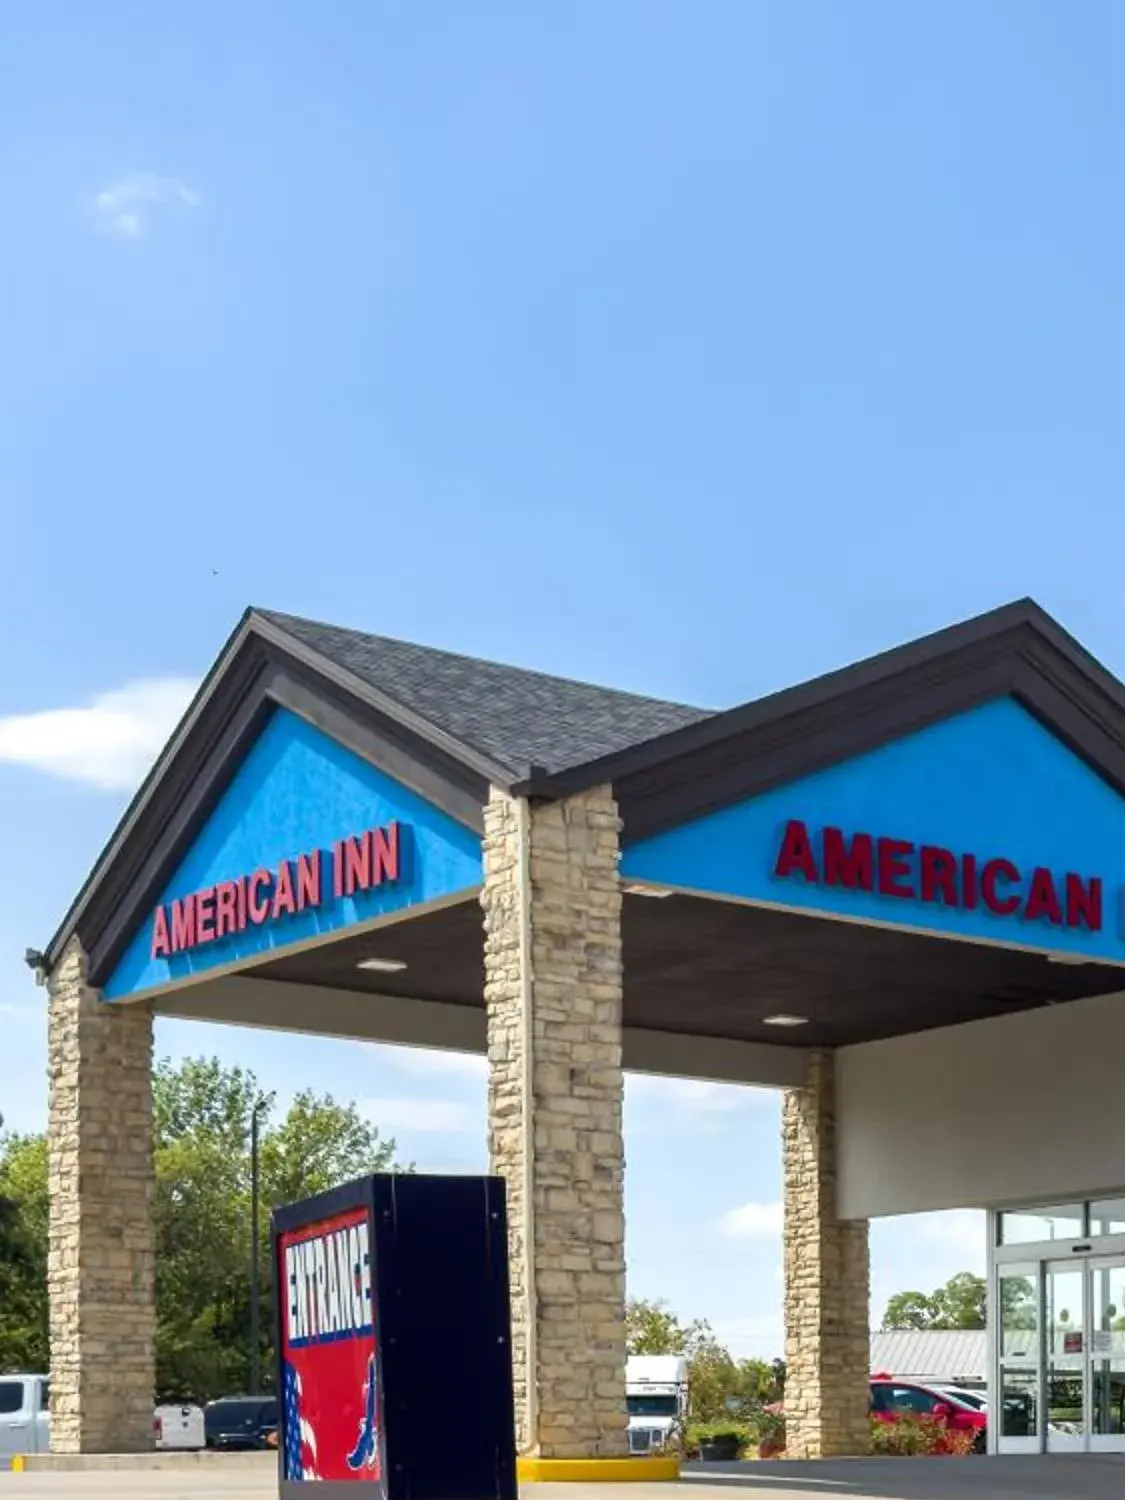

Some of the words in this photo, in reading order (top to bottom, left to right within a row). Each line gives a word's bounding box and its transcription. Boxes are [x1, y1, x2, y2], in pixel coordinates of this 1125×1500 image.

[151, 848, 321, 959] AMERICAN
[333, 821, 399, 897] INN
[775, 819, 1101, 931] AMERICAN
[286, 1223, 373, 1340] ENTRANCE
